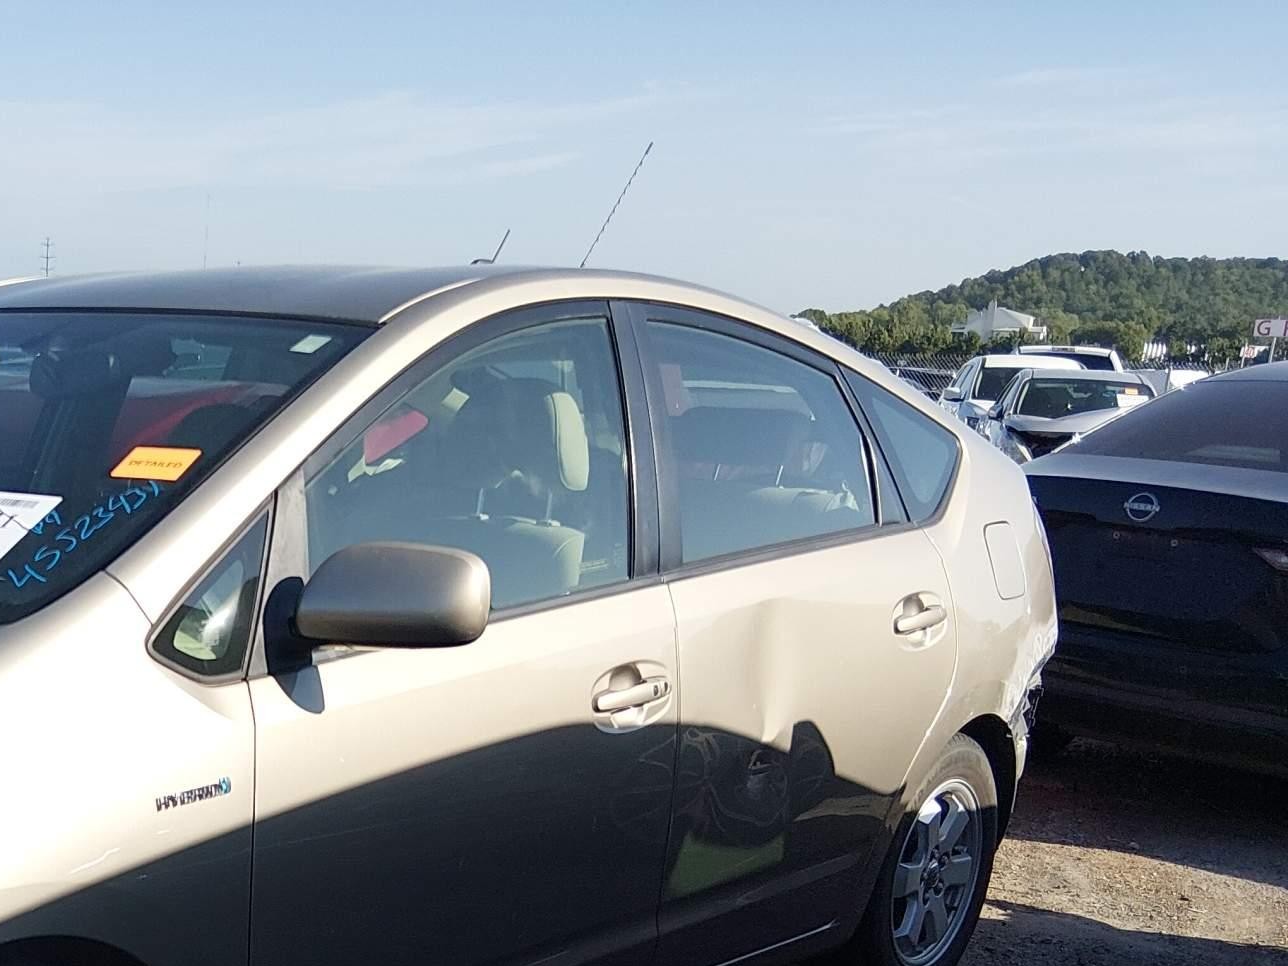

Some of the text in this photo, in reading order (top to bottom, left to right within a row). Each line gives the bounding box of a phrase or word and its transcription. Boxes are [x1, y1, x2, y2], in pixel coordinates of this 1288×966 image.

[1257, 320, 1272, 336] G
[128, 459, 184, 469] DETAILED
[8, 480, 160, 588] 45523431
